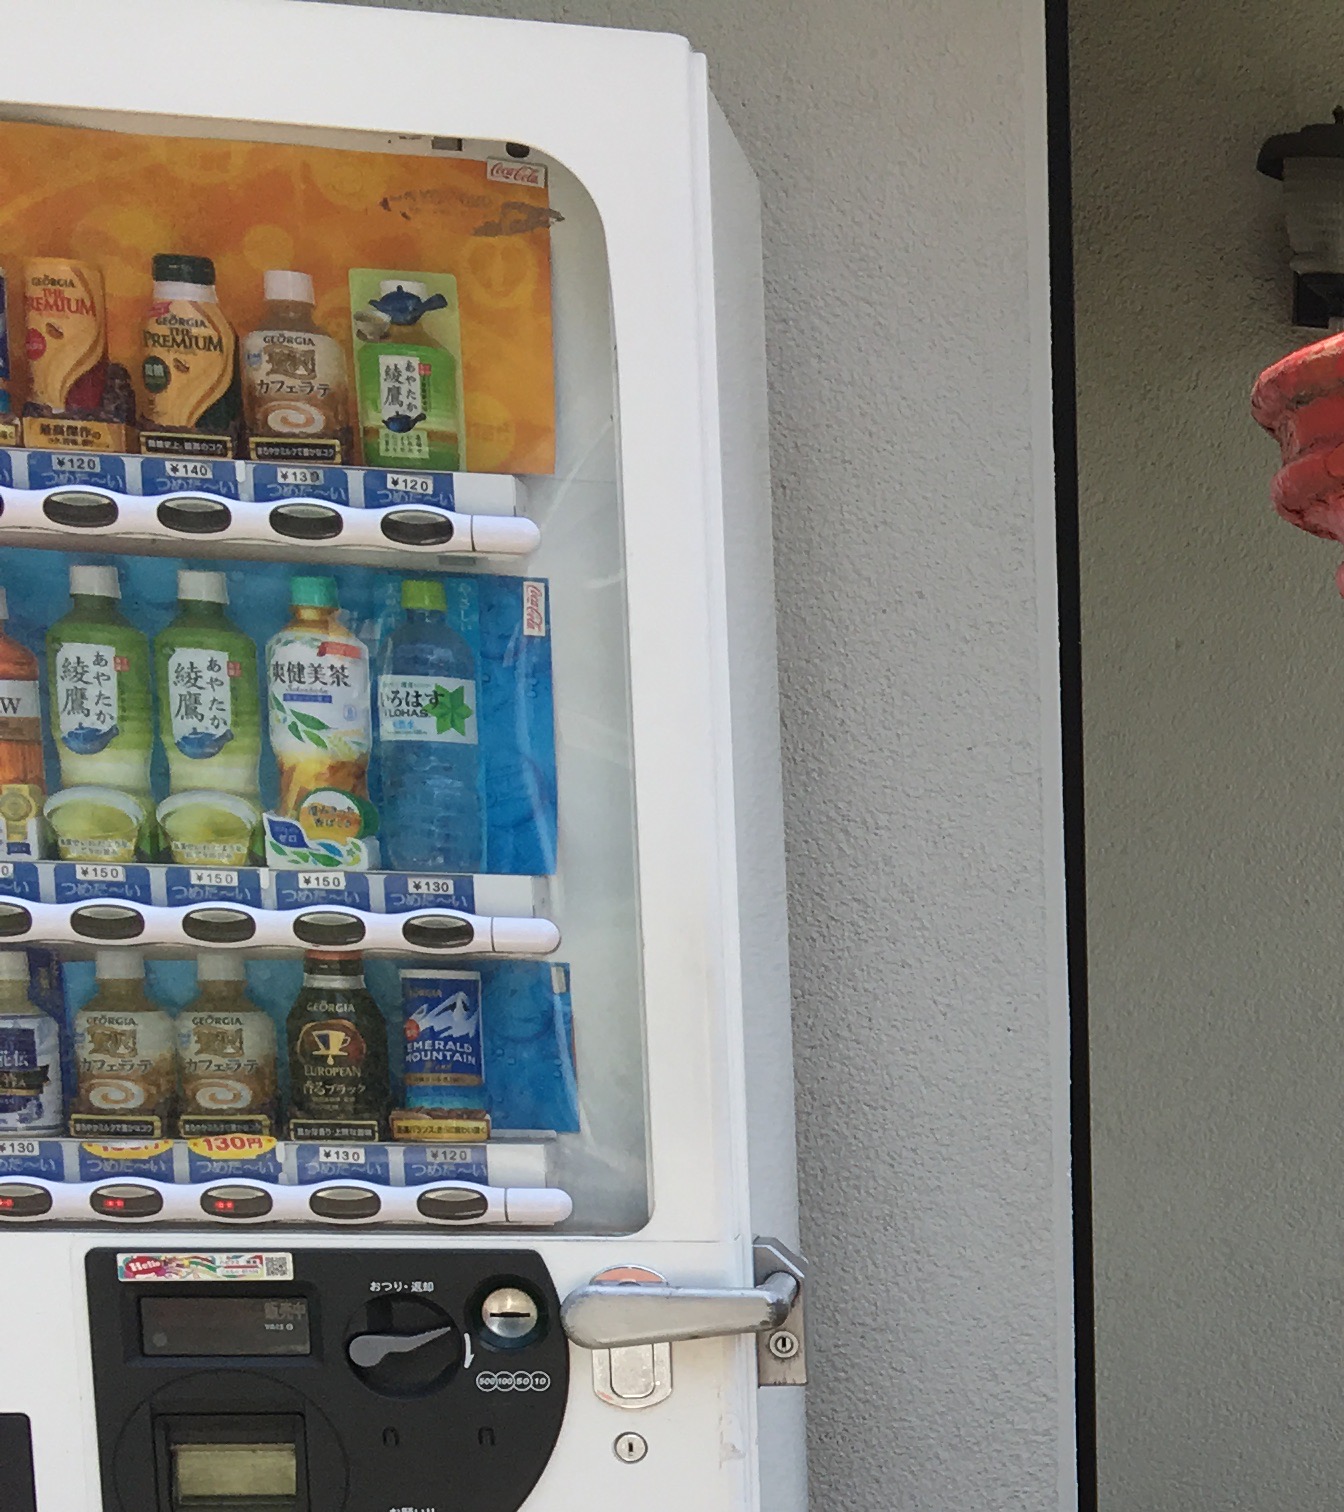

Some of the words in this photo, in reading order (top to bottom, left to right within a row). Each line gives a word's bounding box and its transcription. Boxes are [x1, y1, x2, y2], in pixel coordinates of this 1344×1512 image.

[143, 331, 224, 353] PREMIUM
[257, 379, 330, 398] カフェラテ
[383, 363, 404, 408] 綾鷹
[56, 457, 97, 471] ¥120
[170, 463, 208, 477] ¥140
[391, 477, 428, 492] ¥120
[272, 661, 351, 688] 爽健美茶
[60, 656, 93, 717] 綾鷹
[92, 651, 114, 724] あやたか
[173, 661, 206, 723] 綾鷹
[206, 656, 228, 730] あやたか
[381, 689, 444, 710] いろはす
[81, 866, 119, 878] ¥150
[197, 872, 233, 884] ¥150
[303, 875, 341, 887] ¥150
[413, 880, 450, 893] ¥130
[406, 1040, 472, 1053] EMERALD
[80, 1058, 152, 1074] カフェラテ
[185, 1058, 258, 1074] カフェラテ
[406, 1051, 476, 1066] MOUNTAIN
[304, 1065, 361, 1077] EUROPEAN
[202, 1136, 264, 1151] 130円
[323, 1149, 360, 1162] ¥130
[431, 1150, 468, 1161] ¥120
[129, 1259, 161, 1272] Hello
[370, 1281, 434, 1293] おつり・返却
